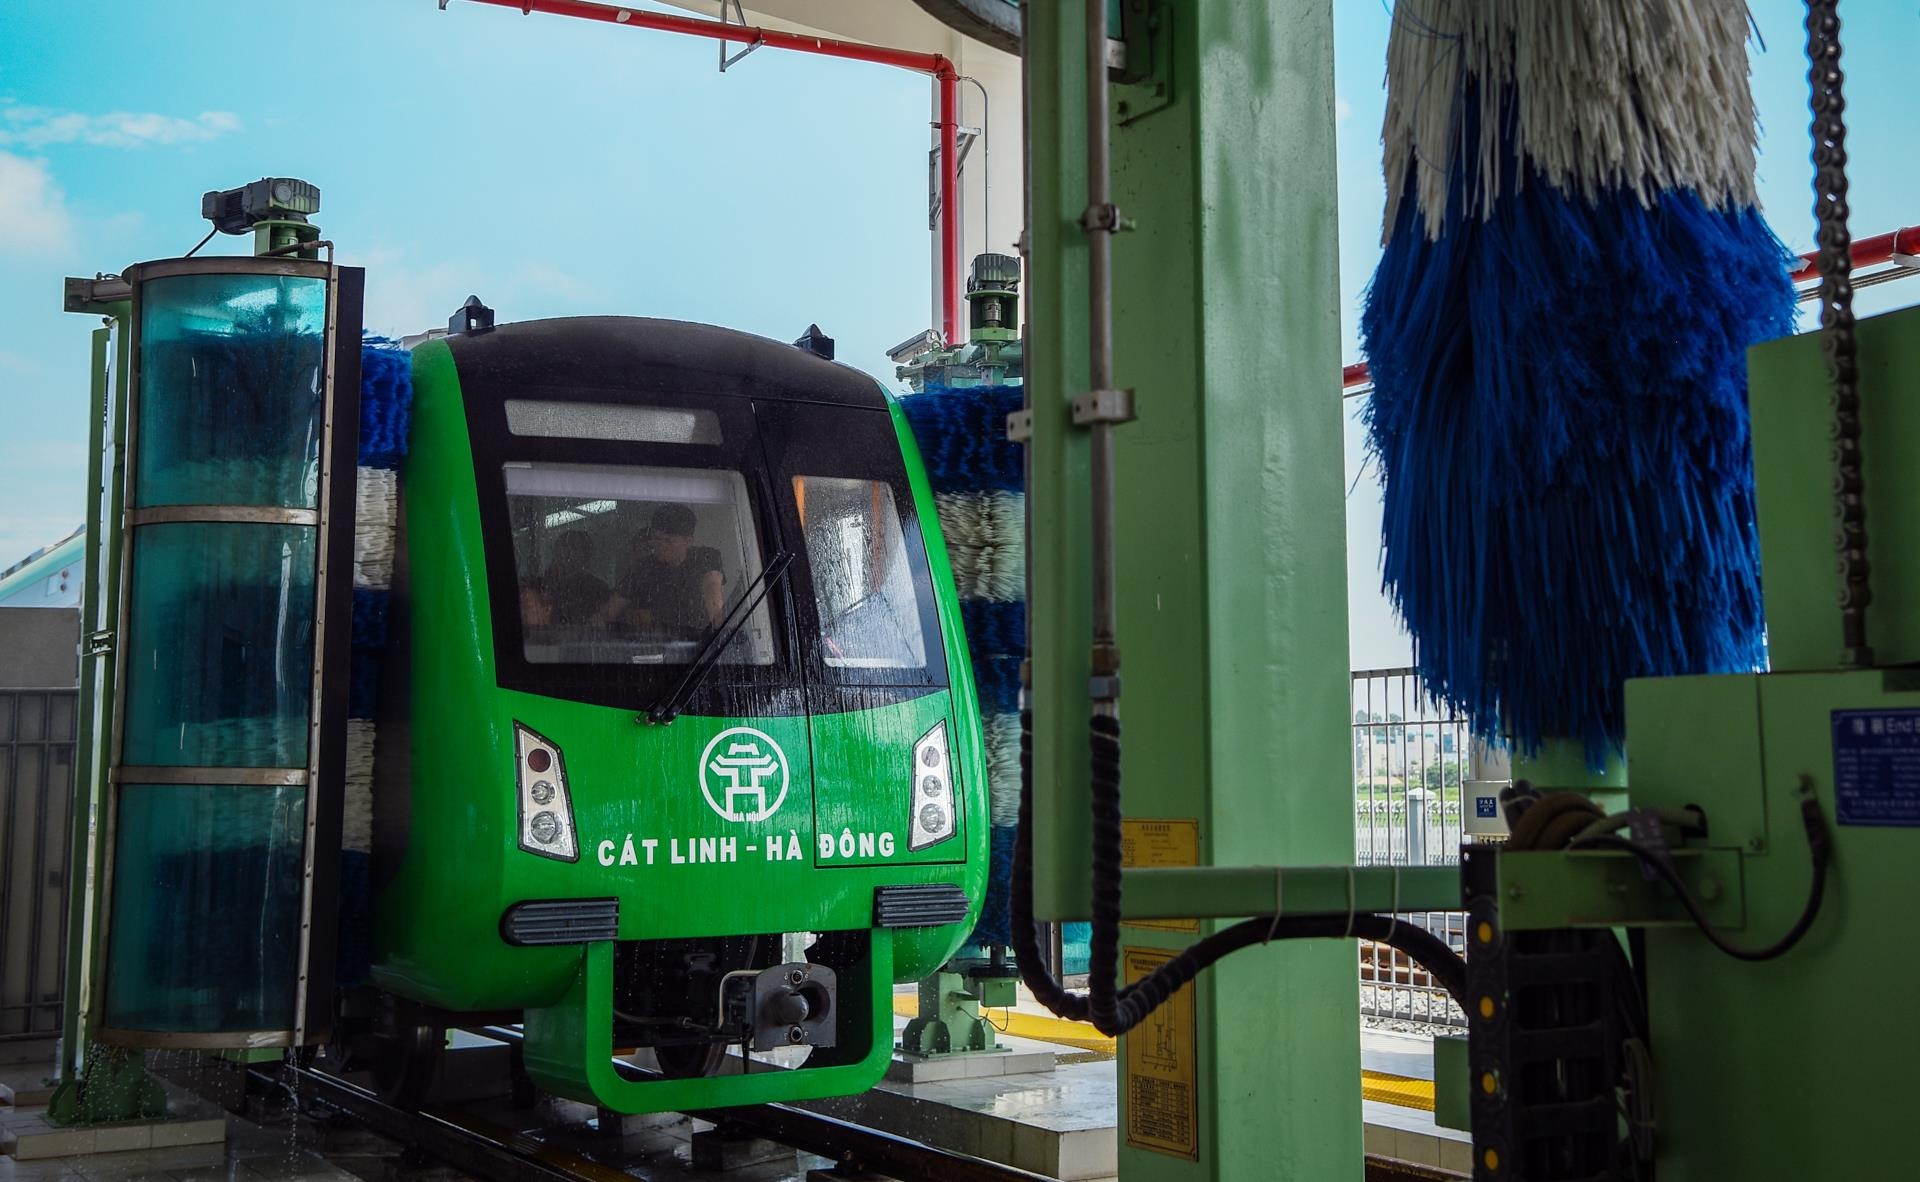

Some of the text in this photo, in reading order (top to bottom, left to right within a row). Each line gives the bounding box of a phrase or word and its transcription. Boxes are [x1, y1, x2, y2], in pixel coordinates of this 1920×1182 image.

[597, 833, 659, 867] CÁT
[670, 836, 737, 864] LINH
[766, 829, 803, 861] HÀ
[819, 827, 895, 859] ĐÔNG
